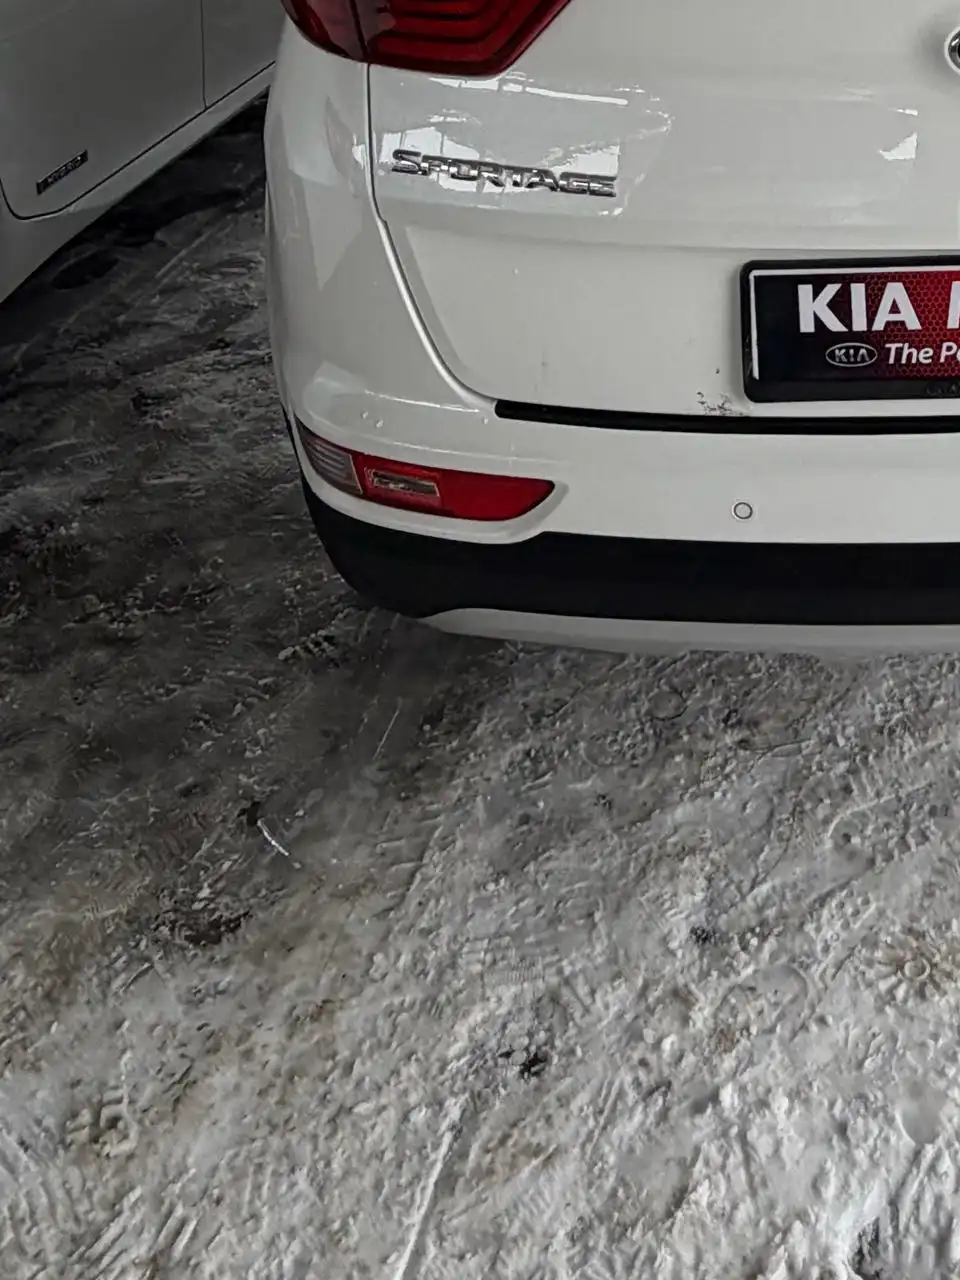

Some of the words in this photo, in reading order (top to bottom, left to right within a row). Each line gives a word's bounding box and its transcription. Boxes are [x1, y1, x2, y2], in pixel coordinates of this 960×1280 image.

[392, 149, 617, 197] SPORTAGE
[797, 281, 922, 333] KIA
[833, 349, 871, 364] KIA
[885, 342, 933, 365] The
